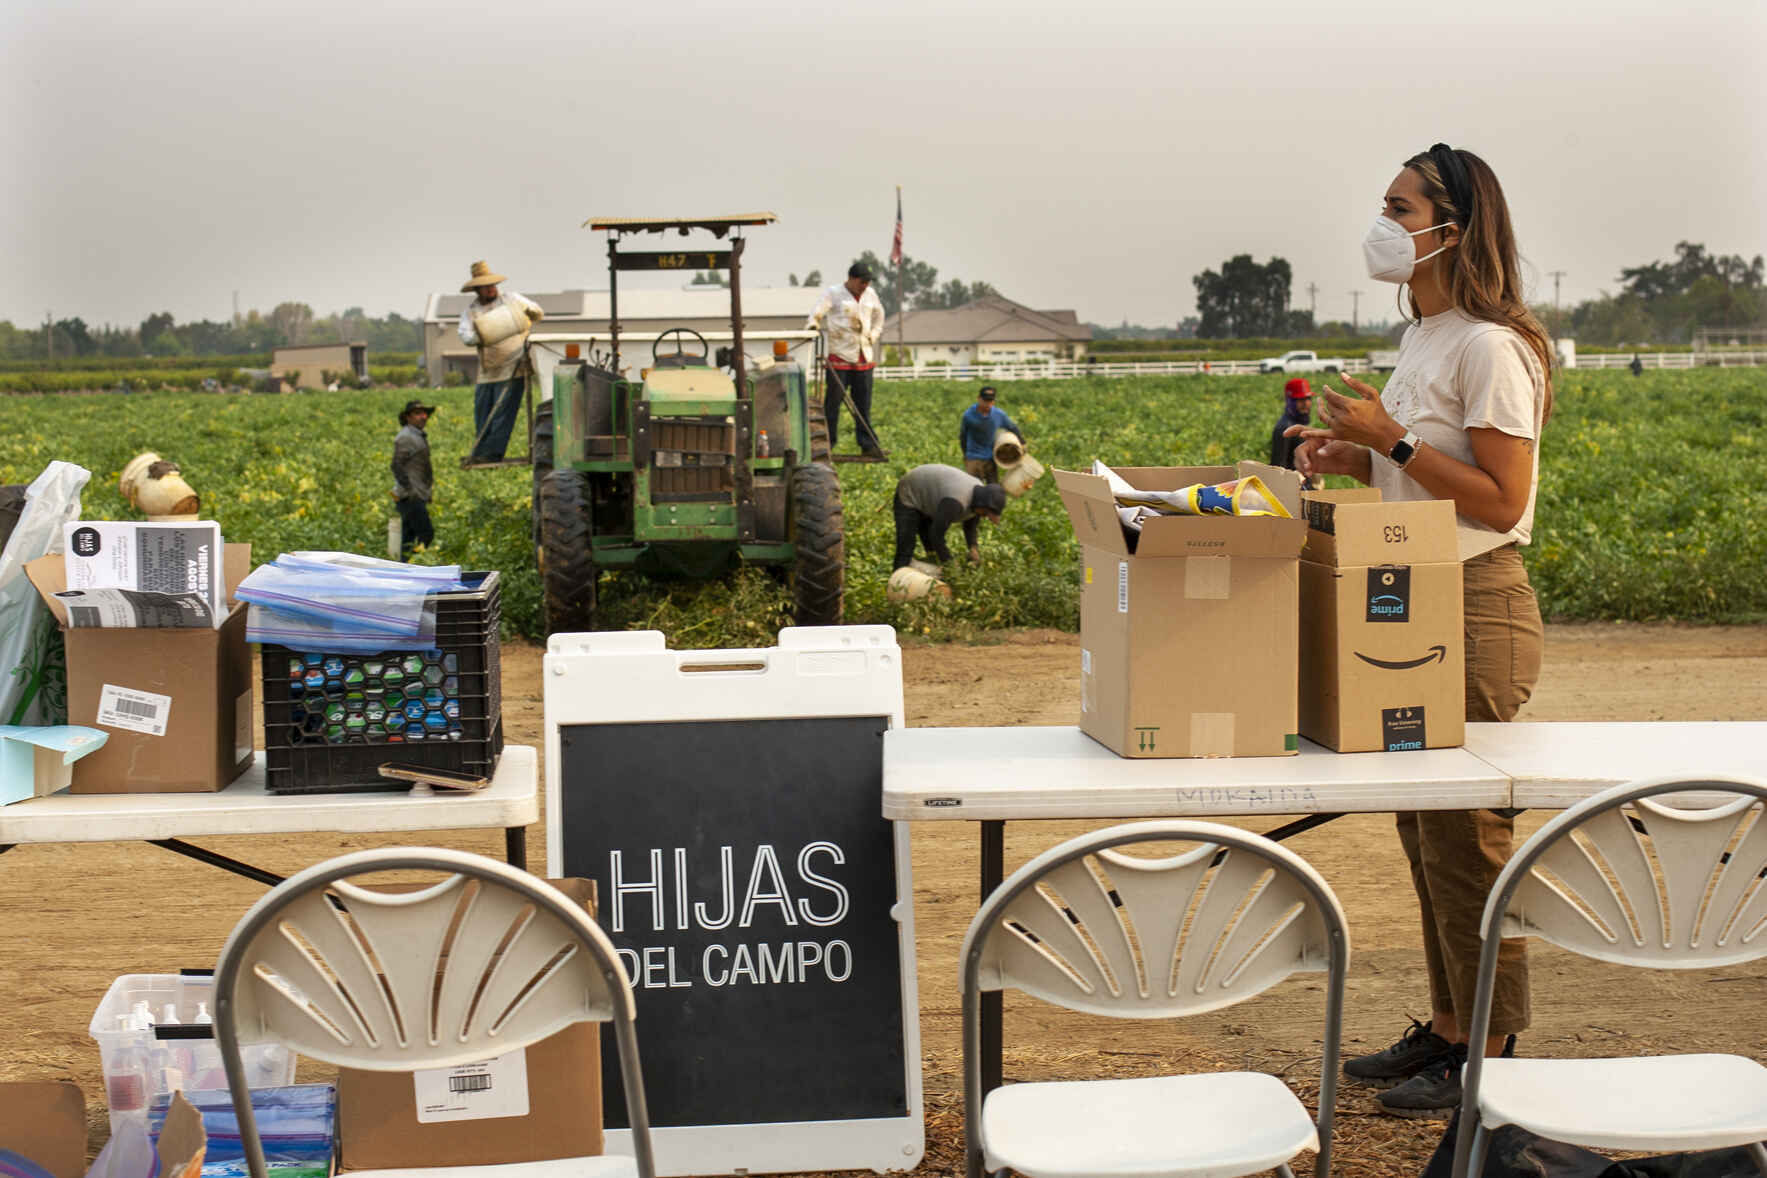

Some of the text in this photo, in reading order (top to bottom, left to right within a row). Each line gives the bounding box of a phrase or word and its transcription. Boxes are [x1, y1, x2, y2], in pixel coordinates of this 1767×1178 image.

[1383, 525, 1409, 543] 153
[1370, 604, 1404, 617] prime
[1389, 740, 1422, 752] prime
[610, 841, 850, 932] HIJAS
[614, 939, 852, 989] DEL CAMPO
